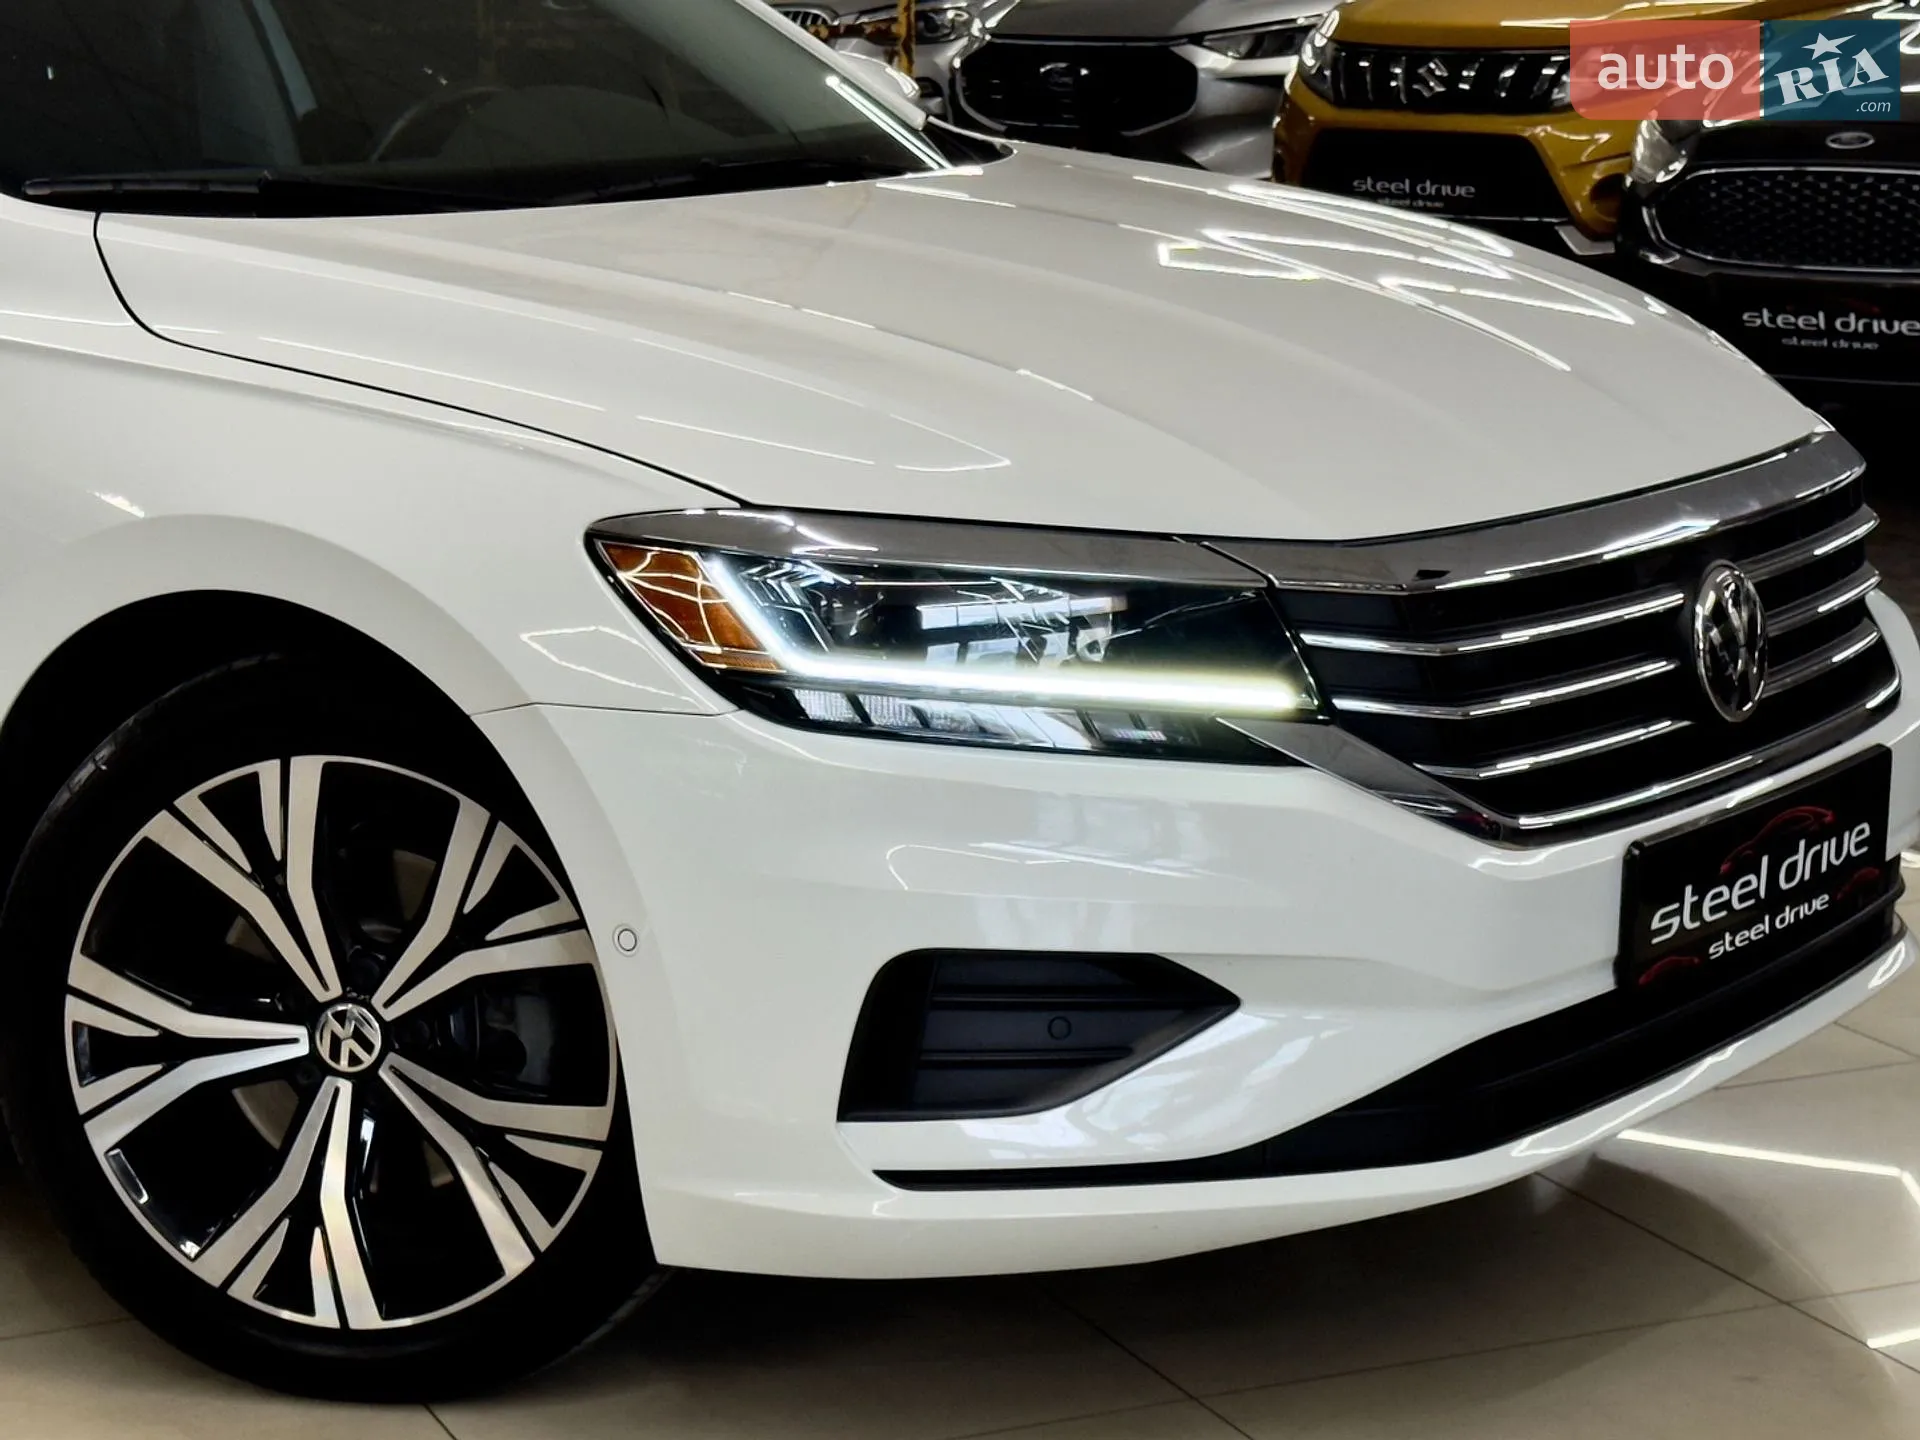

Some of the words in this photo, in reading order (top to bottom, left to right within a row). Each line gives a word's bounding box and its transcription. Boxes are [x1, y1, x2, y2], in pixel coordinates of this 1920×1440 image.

[1353, 176, 1410, 194] steel
[1416, 179, 1476, 198] drive
[1742, 308, 1825, 330] steel
[1835, 312, 1920, 336] drive
[1650, 855, 1769, 944] steel
[1779, 822, 1871, 891] drive
[1708, 915, 1770, 960] steel
[1775, 893, 1829, 930] drive
